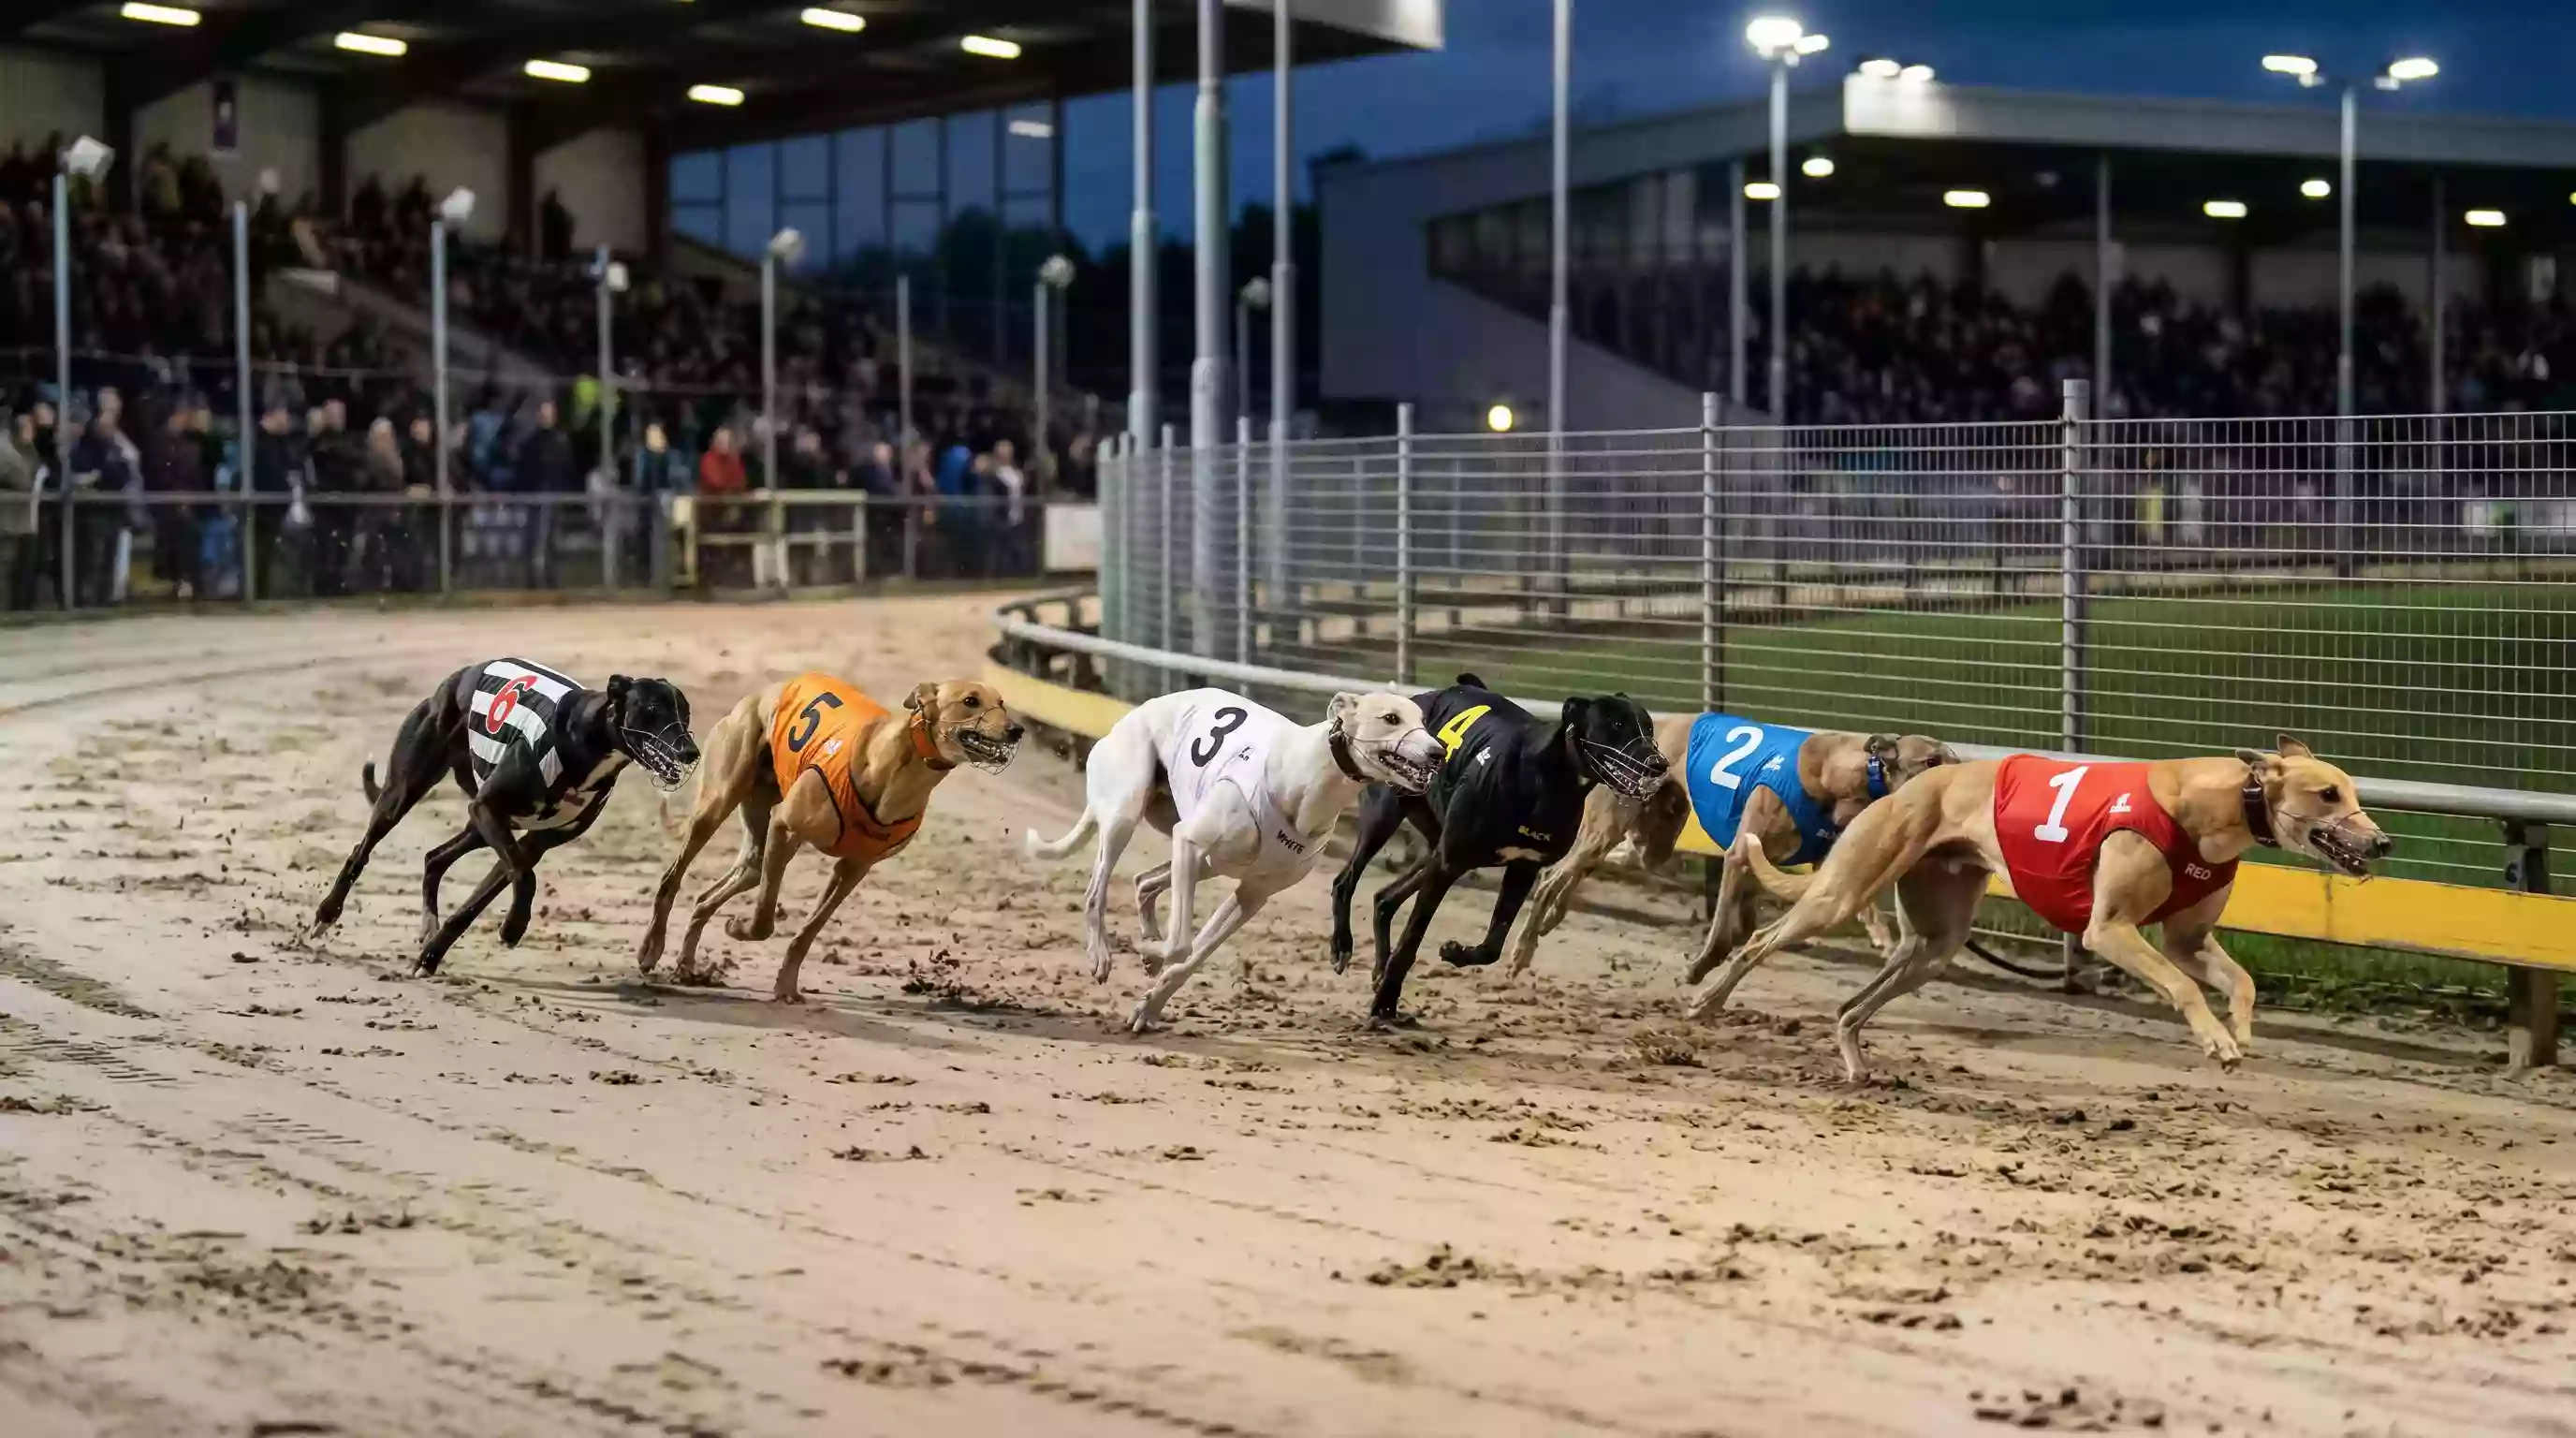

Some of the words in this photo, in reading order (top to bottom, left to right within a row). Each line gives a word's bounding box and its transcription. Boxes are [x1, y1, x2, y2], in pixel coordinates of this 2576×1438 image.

[486, 675, 538, 735] 6
[788, 692, 843, 753] 5
[1437, 705, 1492, 763] 4
[1191, 707, 1248, 768] 3
[1710, 726, 1764, 790] 2
[1517, 825, 1553, 842] BLACK
[2034, 766, 2090, 843] 1
[1277, 829, 1305, 854] WHITE
[2185, 862, 2212, 880] RED
